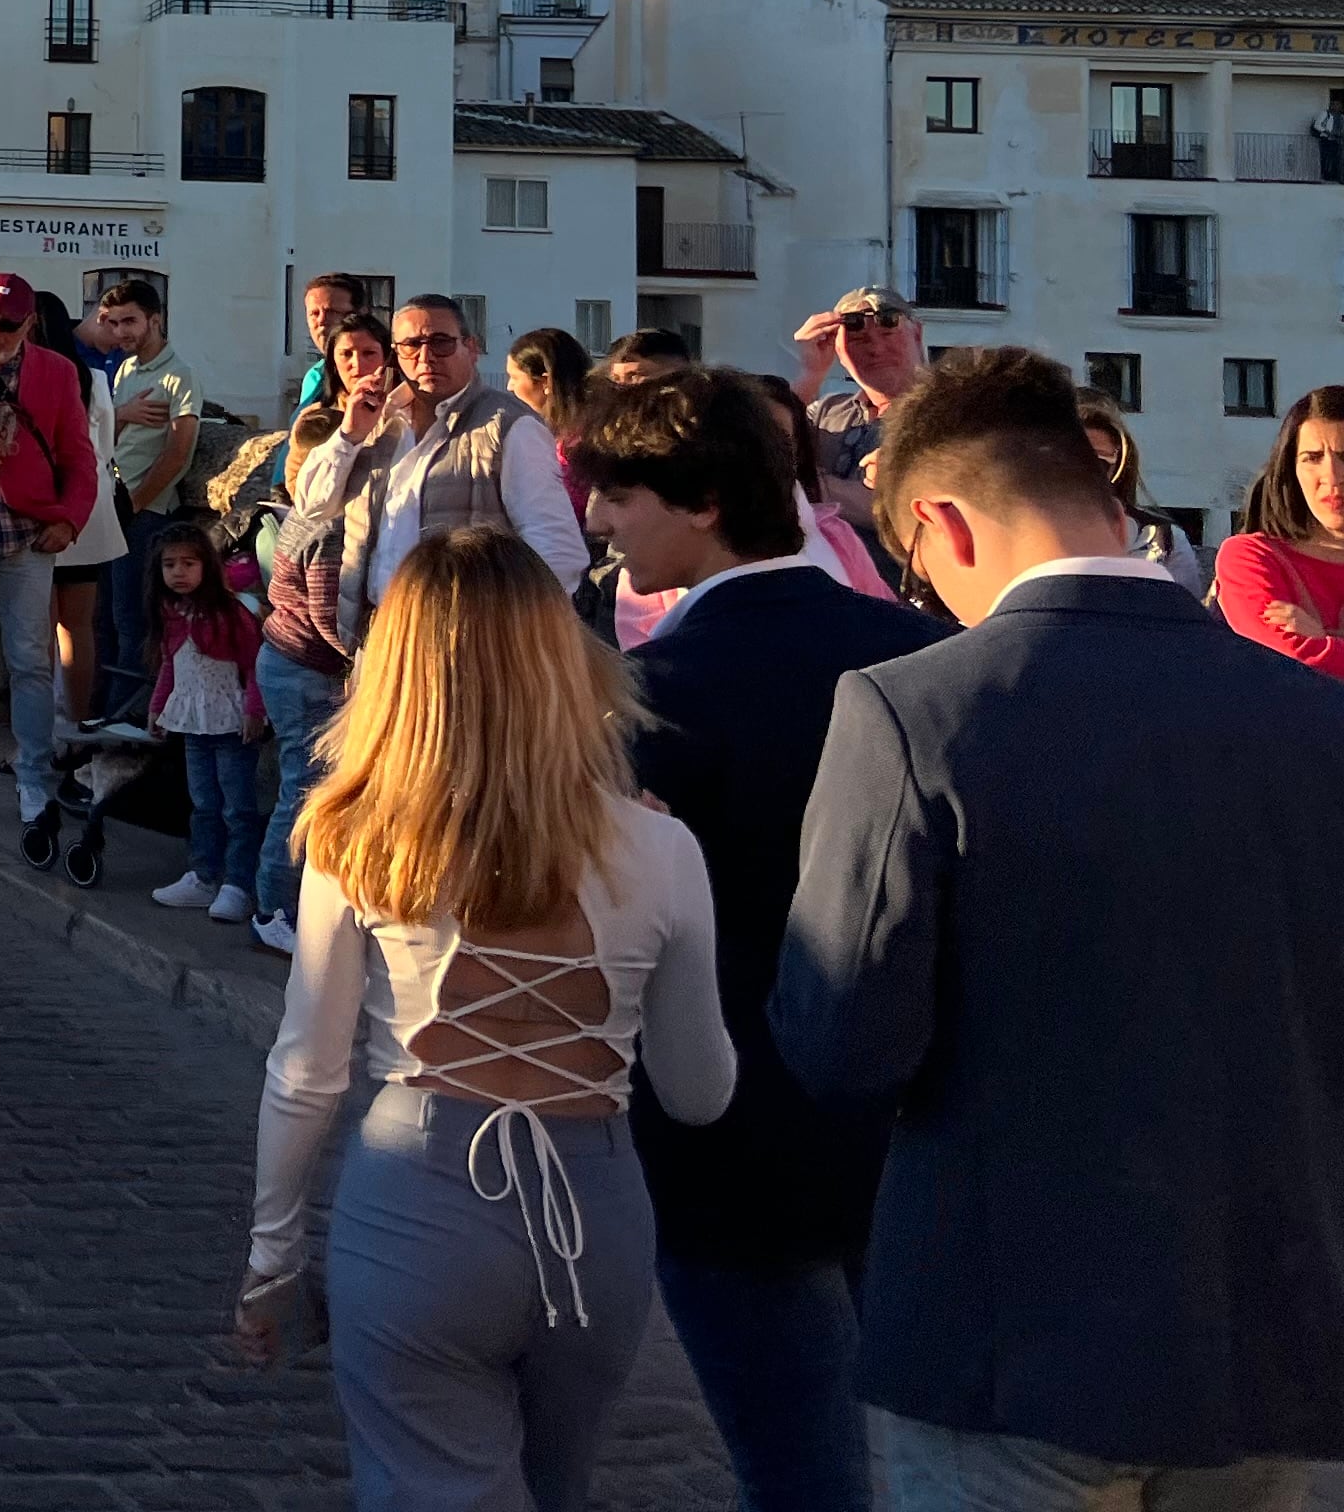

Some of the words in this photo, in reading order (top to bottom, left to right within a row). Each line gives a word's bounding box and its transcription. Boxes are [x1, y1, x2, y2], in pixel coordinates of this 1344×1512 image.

[1058, 26, 1194, 48] HOTEL
[43, 237, 80, 255] Don
[92, 238, 160, 260] Miguel
